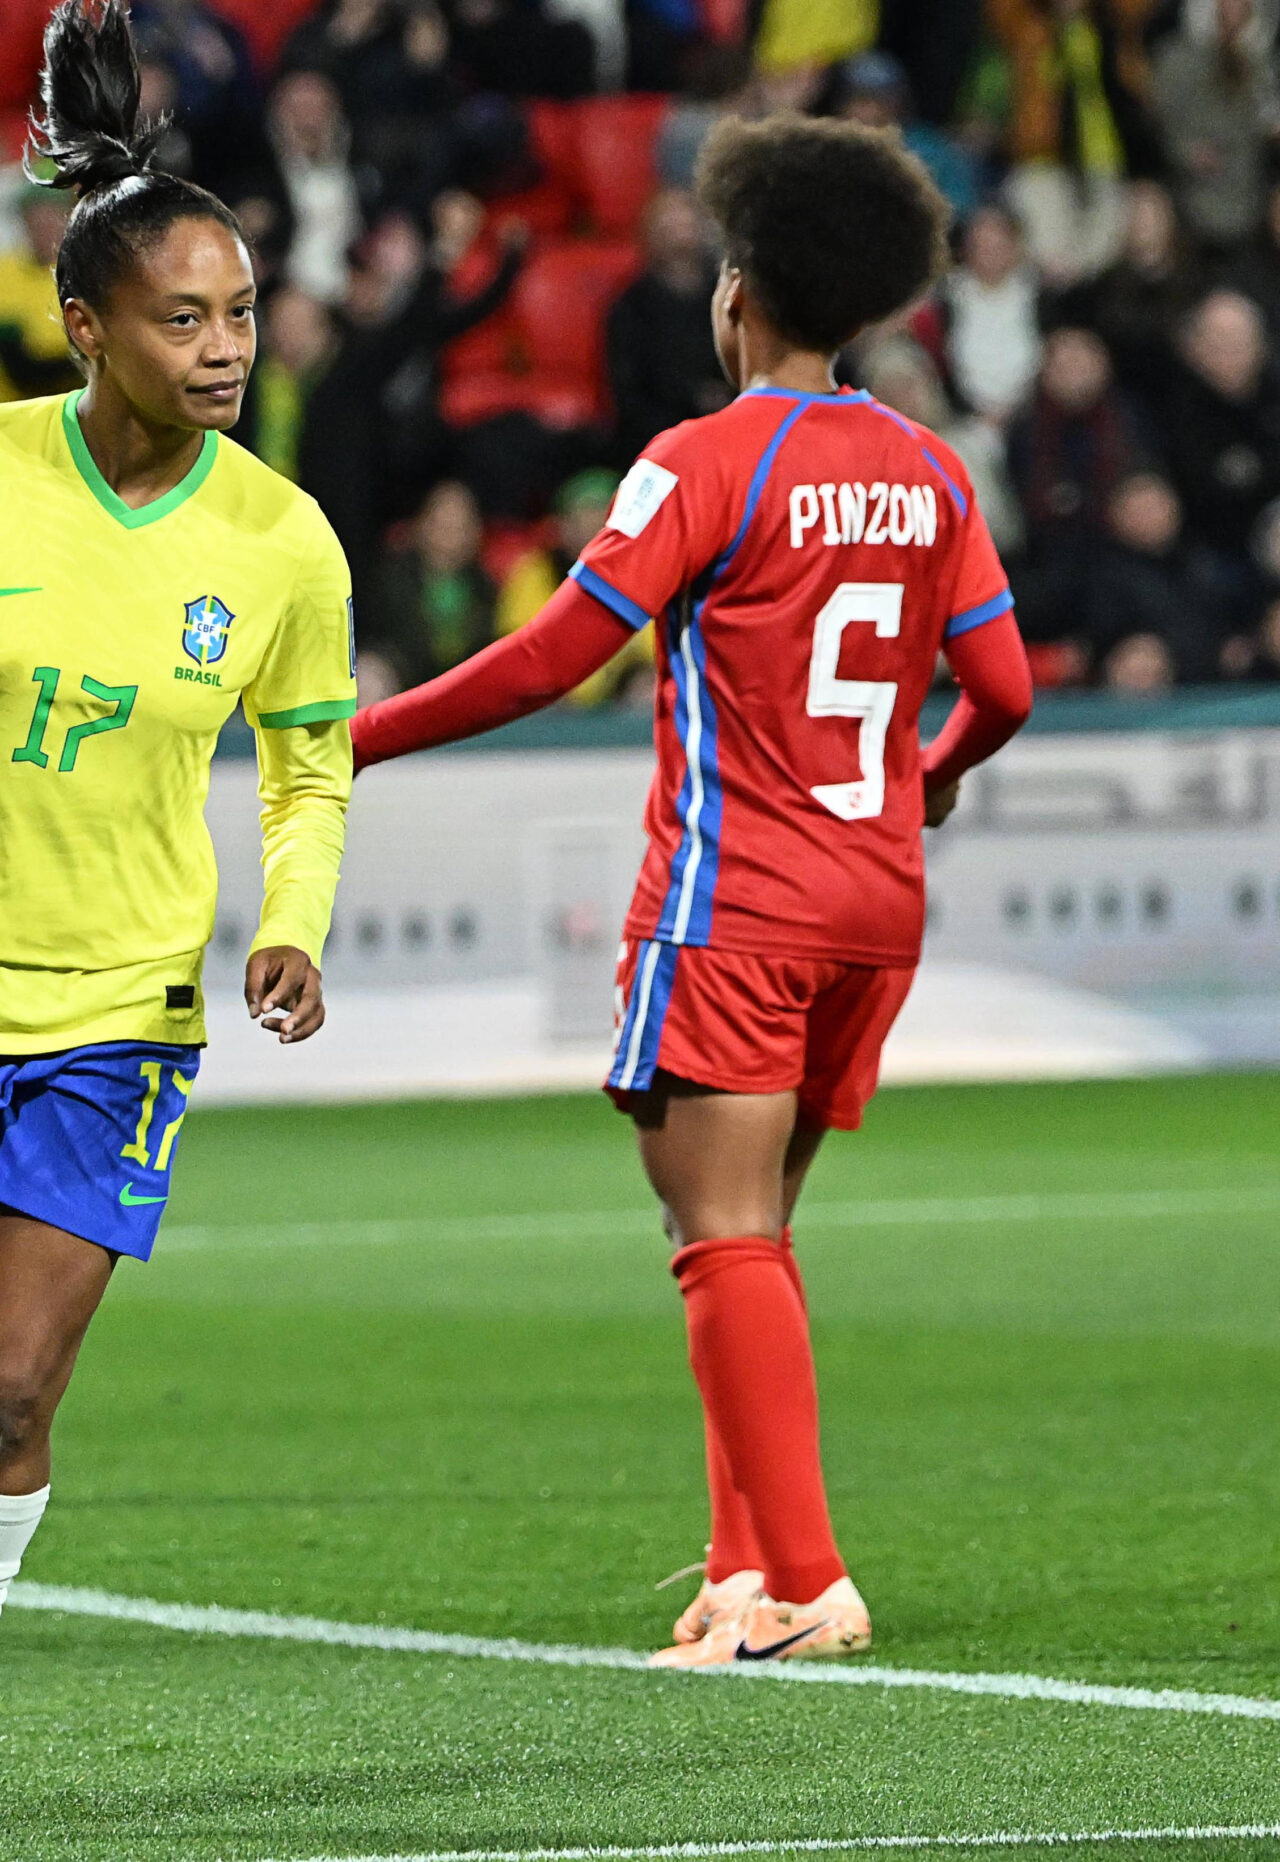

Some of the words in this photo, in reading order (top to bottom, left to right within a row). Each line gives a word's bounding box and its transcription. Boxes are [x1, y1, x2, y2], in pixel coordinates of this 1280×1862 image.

[789, 481, 938, 549] PINZON
[197, 622, 216, 634] CBF
[11, 665, 139, 773] 17
[173, 666, 223, 687] BRASIL
[806, 582, 905, 821] 5
[120, 1061, 195, 1171] 17
